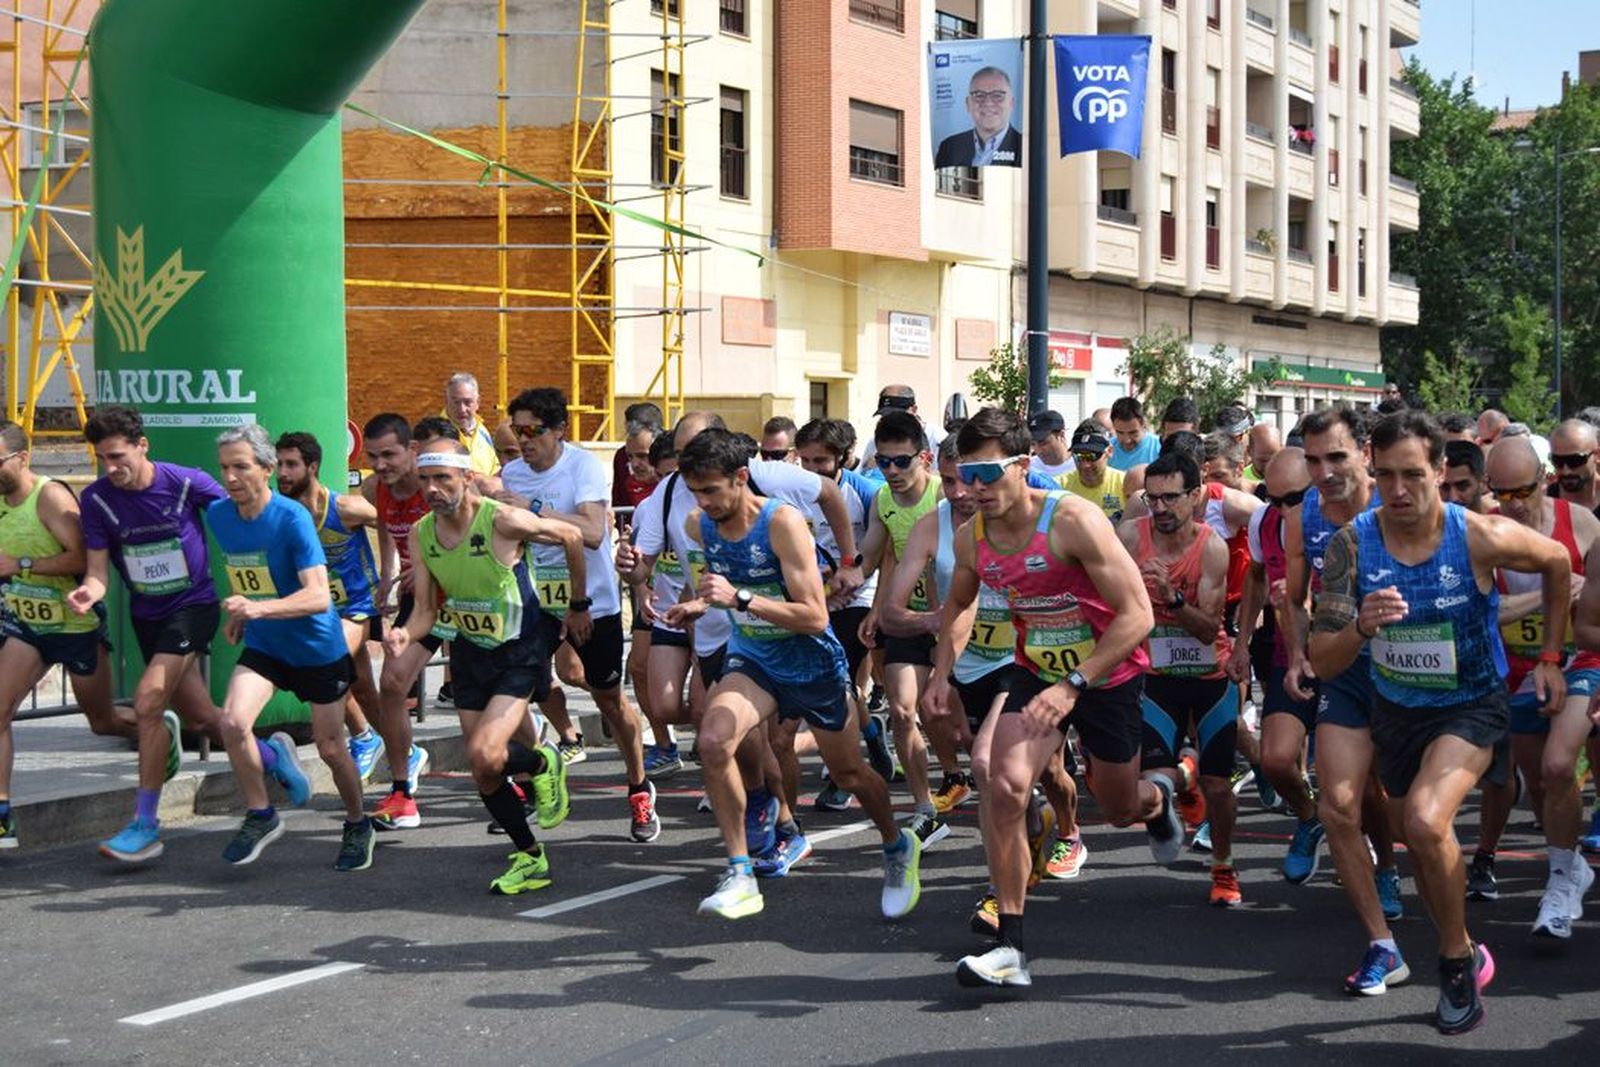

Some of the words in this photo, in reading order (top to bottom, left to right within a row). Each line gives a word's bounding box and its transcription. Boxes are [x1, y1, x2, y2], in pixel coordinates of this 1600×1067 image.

[1073, 65, 1131, 82] VOTA
[201, 415, 244, 425] ZAMORA
[144, 562, 171, 579] PEÓN
[236, 569, 261, 591] 18
[541, 583, 568, 605] 14
[11, 598, 53, 621] 136
[1042, 648, 1080, 672] 20
[1169, 647, 1202, 664] JORGE
[1385, 652, 1441, 669] MARCOS
